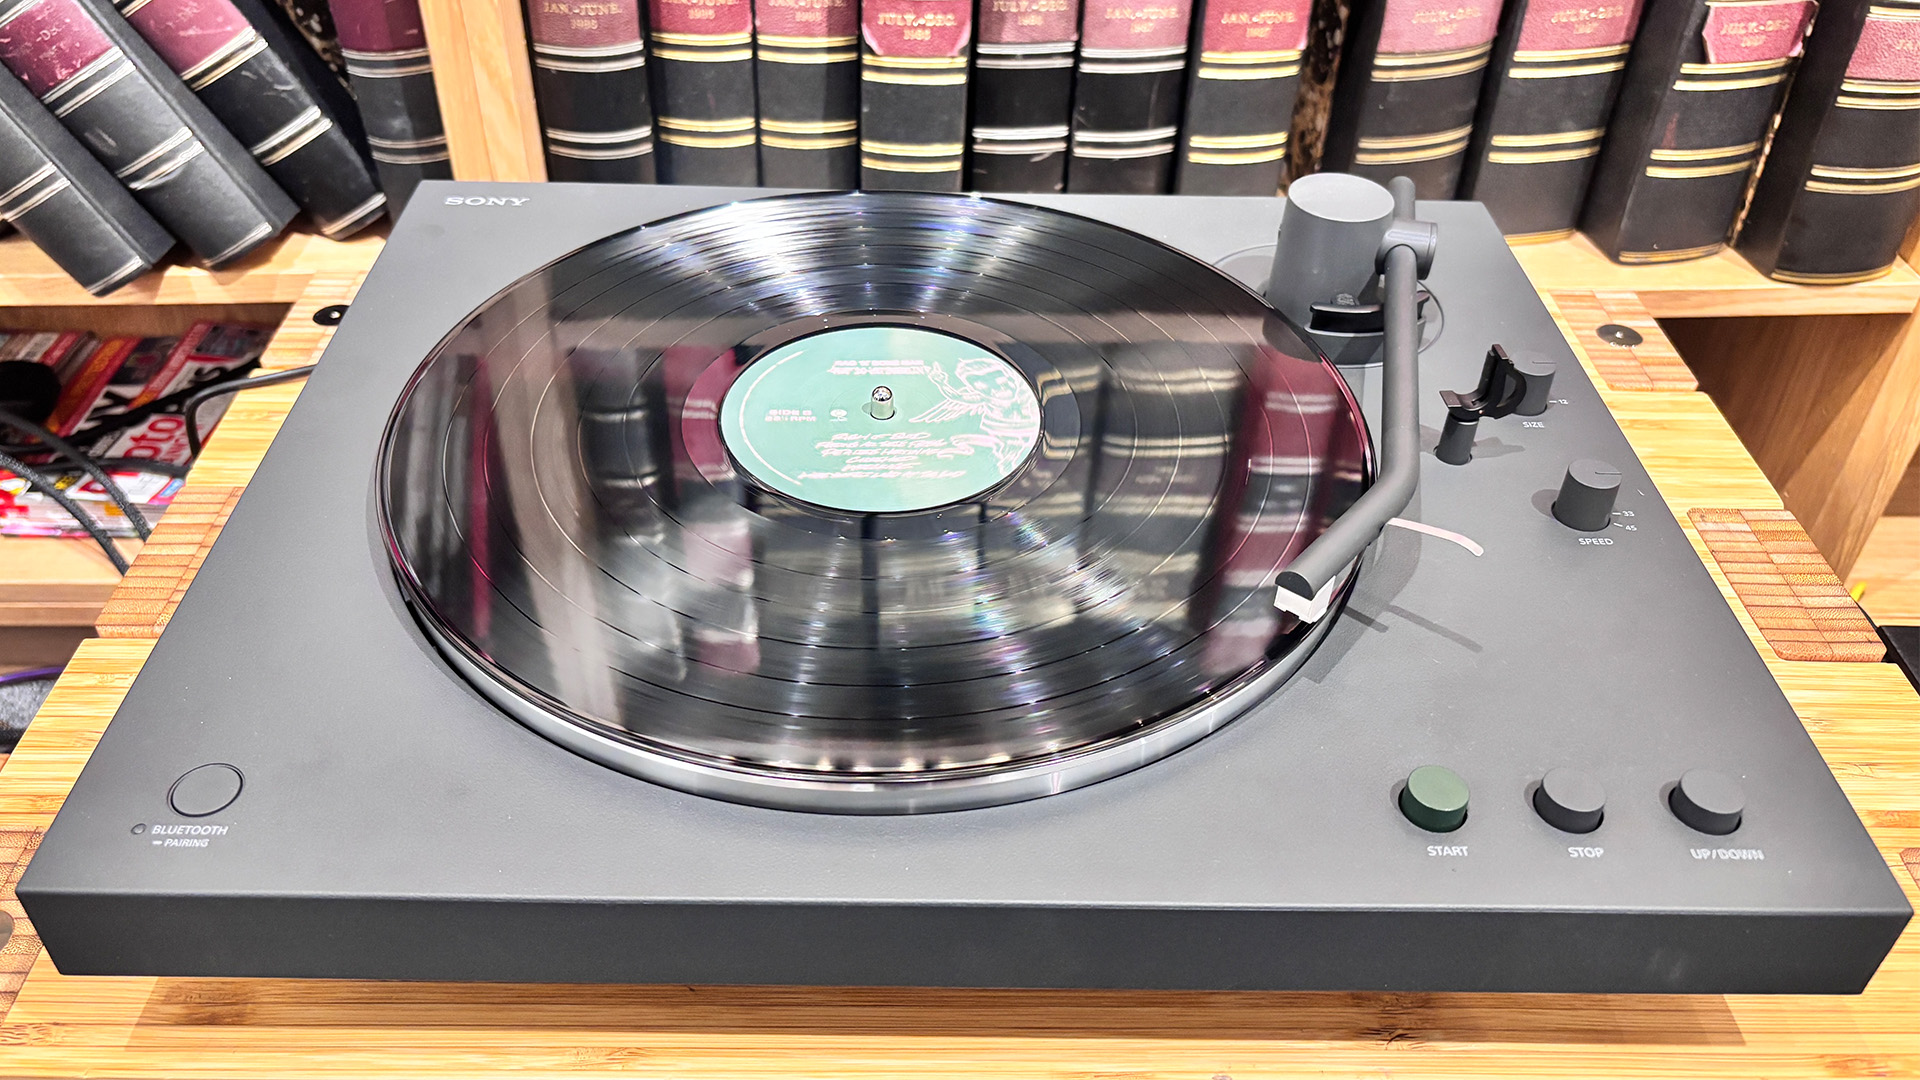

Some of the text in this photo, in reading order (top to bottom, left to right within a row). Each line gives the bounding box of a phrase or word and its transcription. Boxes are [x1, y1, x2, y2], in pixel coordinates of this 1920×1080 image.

[445, 196, 530, 206] SONY
[1522, 421, 1545, 429] SIZE
[1625, 524, 1638, 532] 45
[1578, 537, 1614, 546] SPEED
[151, 824, 229, 836] BLUETOOTH
[164, 838, 210, 848] PAIRING
[1426, 845, 1469, 857] START
[1567, 846, 1605, 858] STOP
[1690, 847, 1766, 861] UP/DOWN
